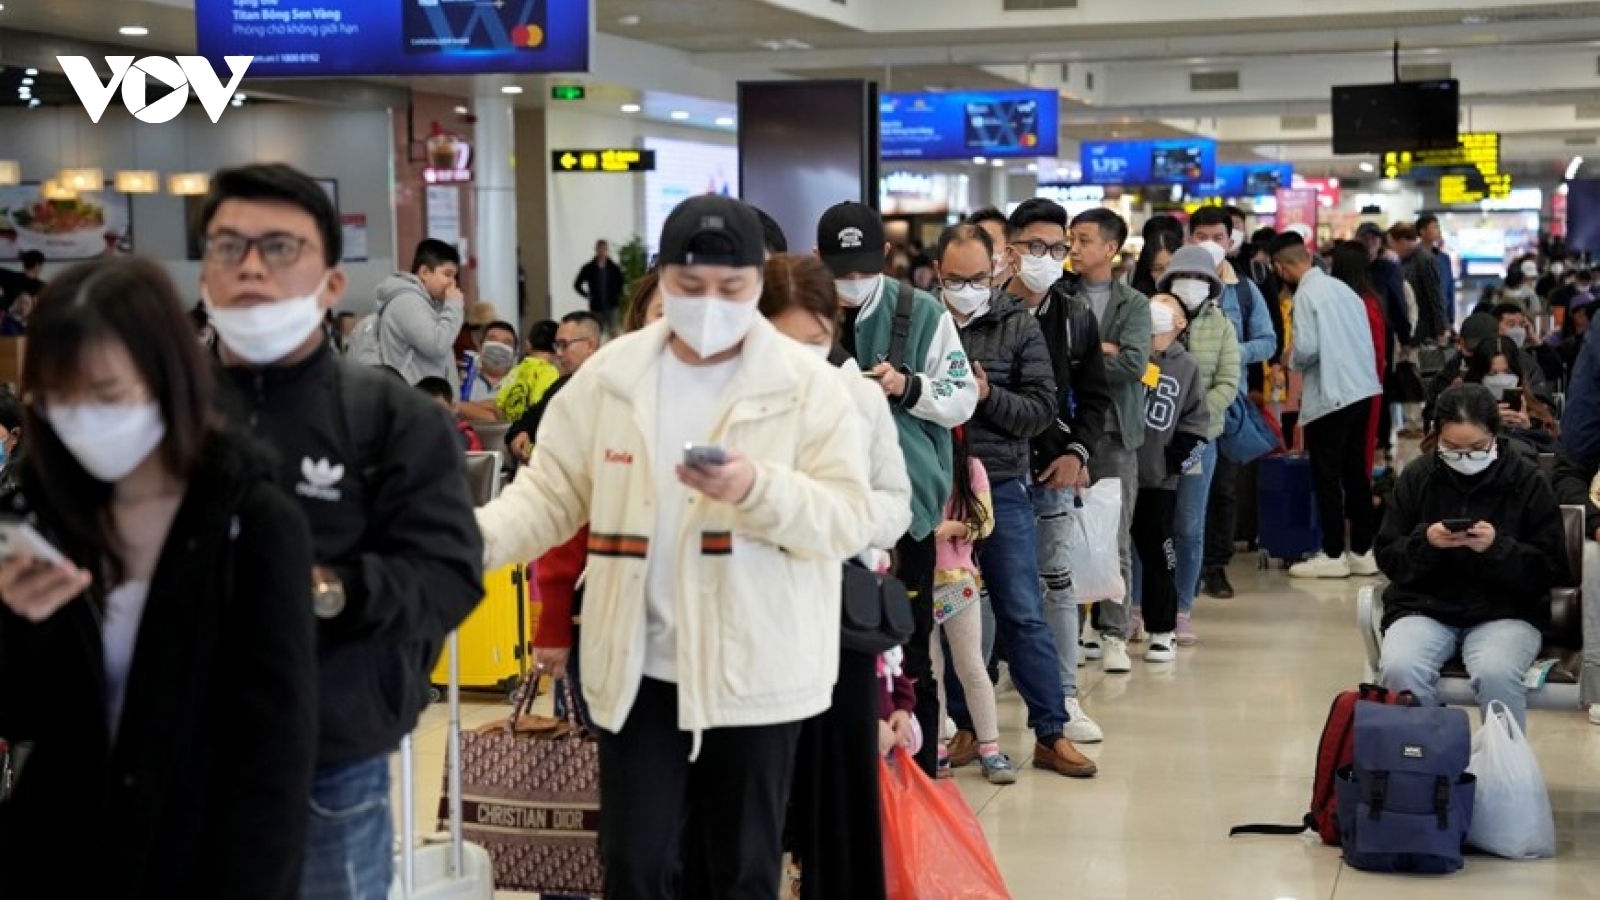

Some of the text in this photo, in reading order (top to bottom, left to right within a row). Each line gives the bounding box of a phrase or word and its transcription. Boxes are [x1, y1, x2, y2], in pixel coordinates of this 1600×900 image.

[232, 7, 341, 22] Titan Bông Sen Vàng
[232, 23, 359, 37] Phòng chờ không giới hạn
[477, 803, 584, 830] CHRISTIAN DIOR
